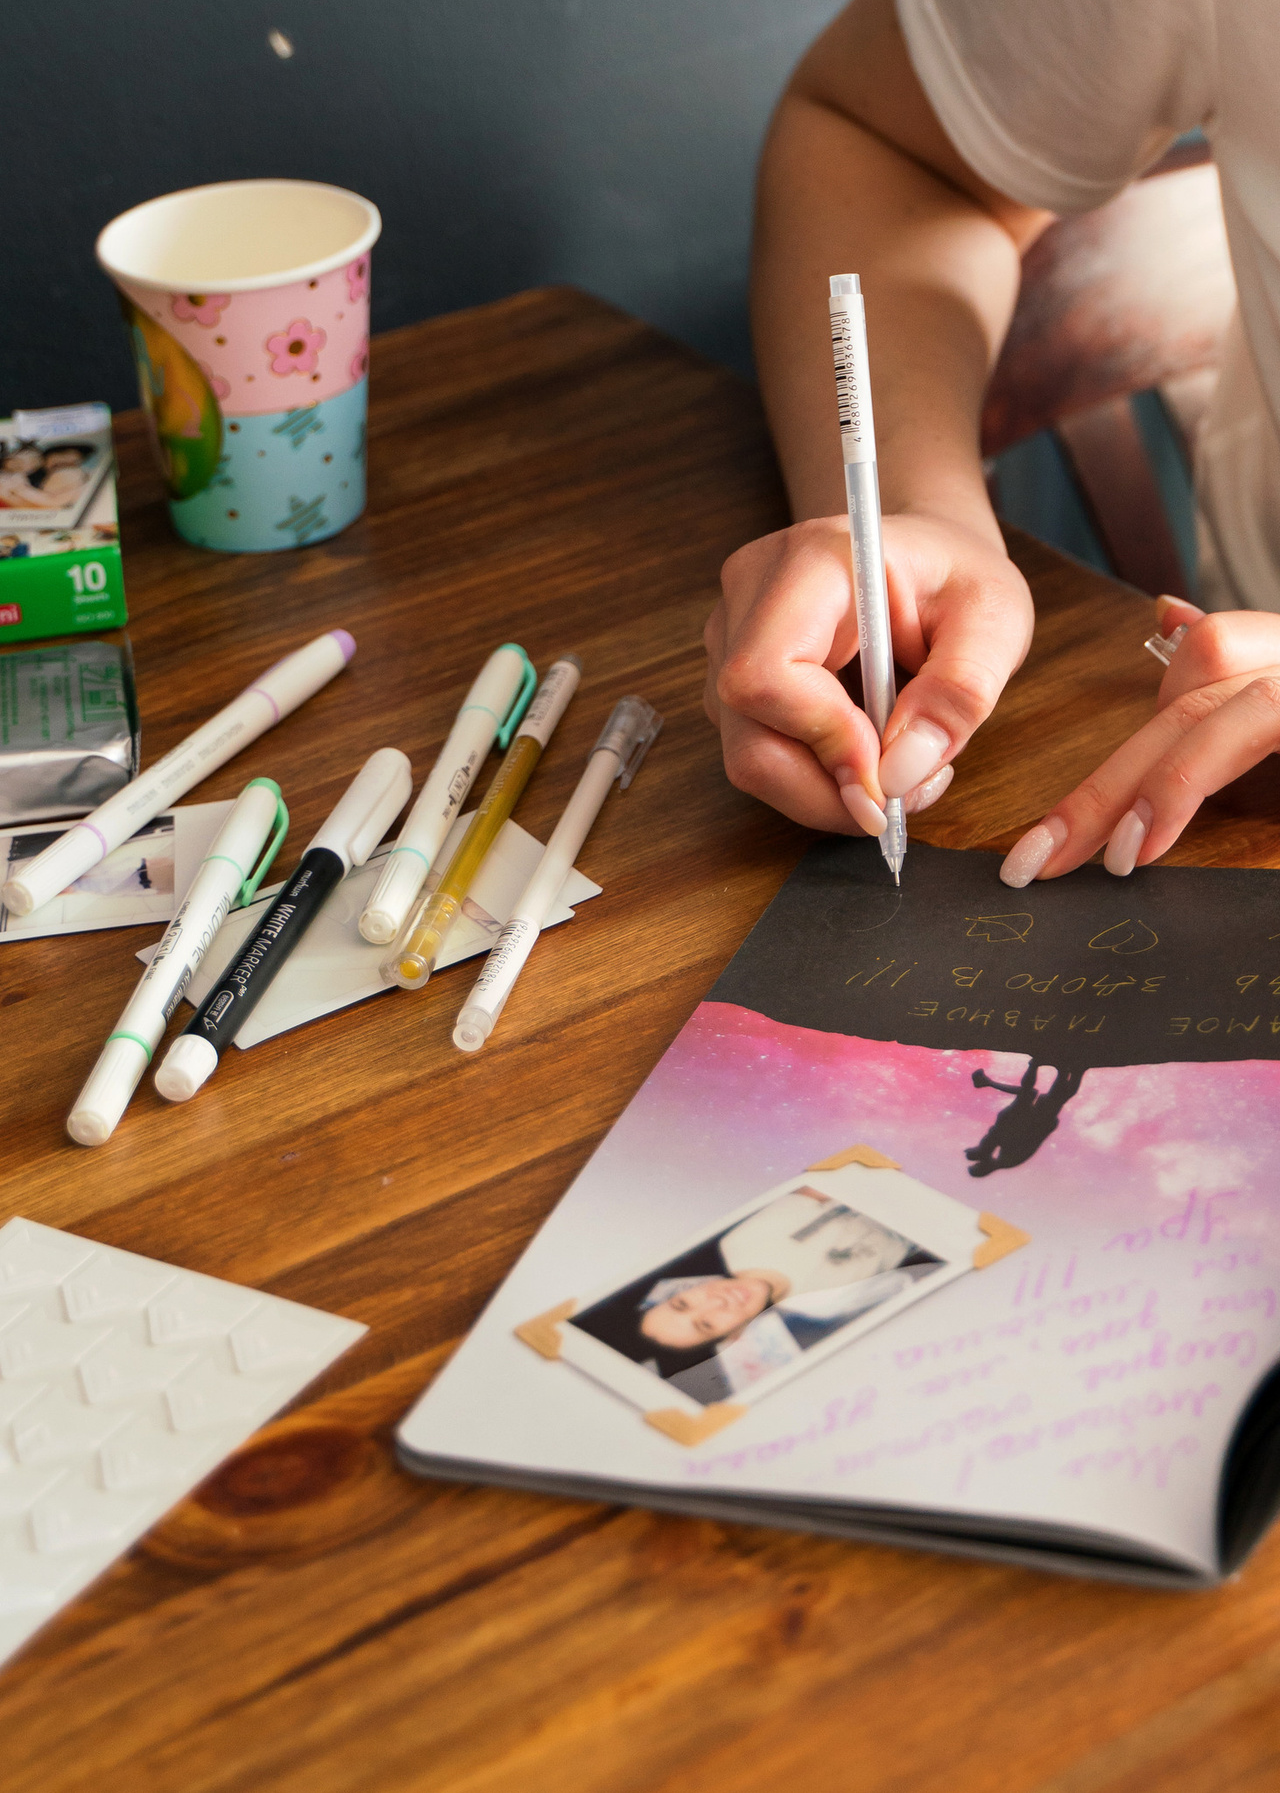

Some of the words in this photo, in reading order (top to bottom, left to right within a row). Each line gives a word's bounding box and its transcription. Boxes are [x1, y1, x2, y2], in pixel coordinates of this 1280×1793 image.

[67, 561, 107, 593] 10
[261, 903, 297, 939] WHITE
[229, 937, 272, 985] MARKER
[237, 984, 247, 997] pen
